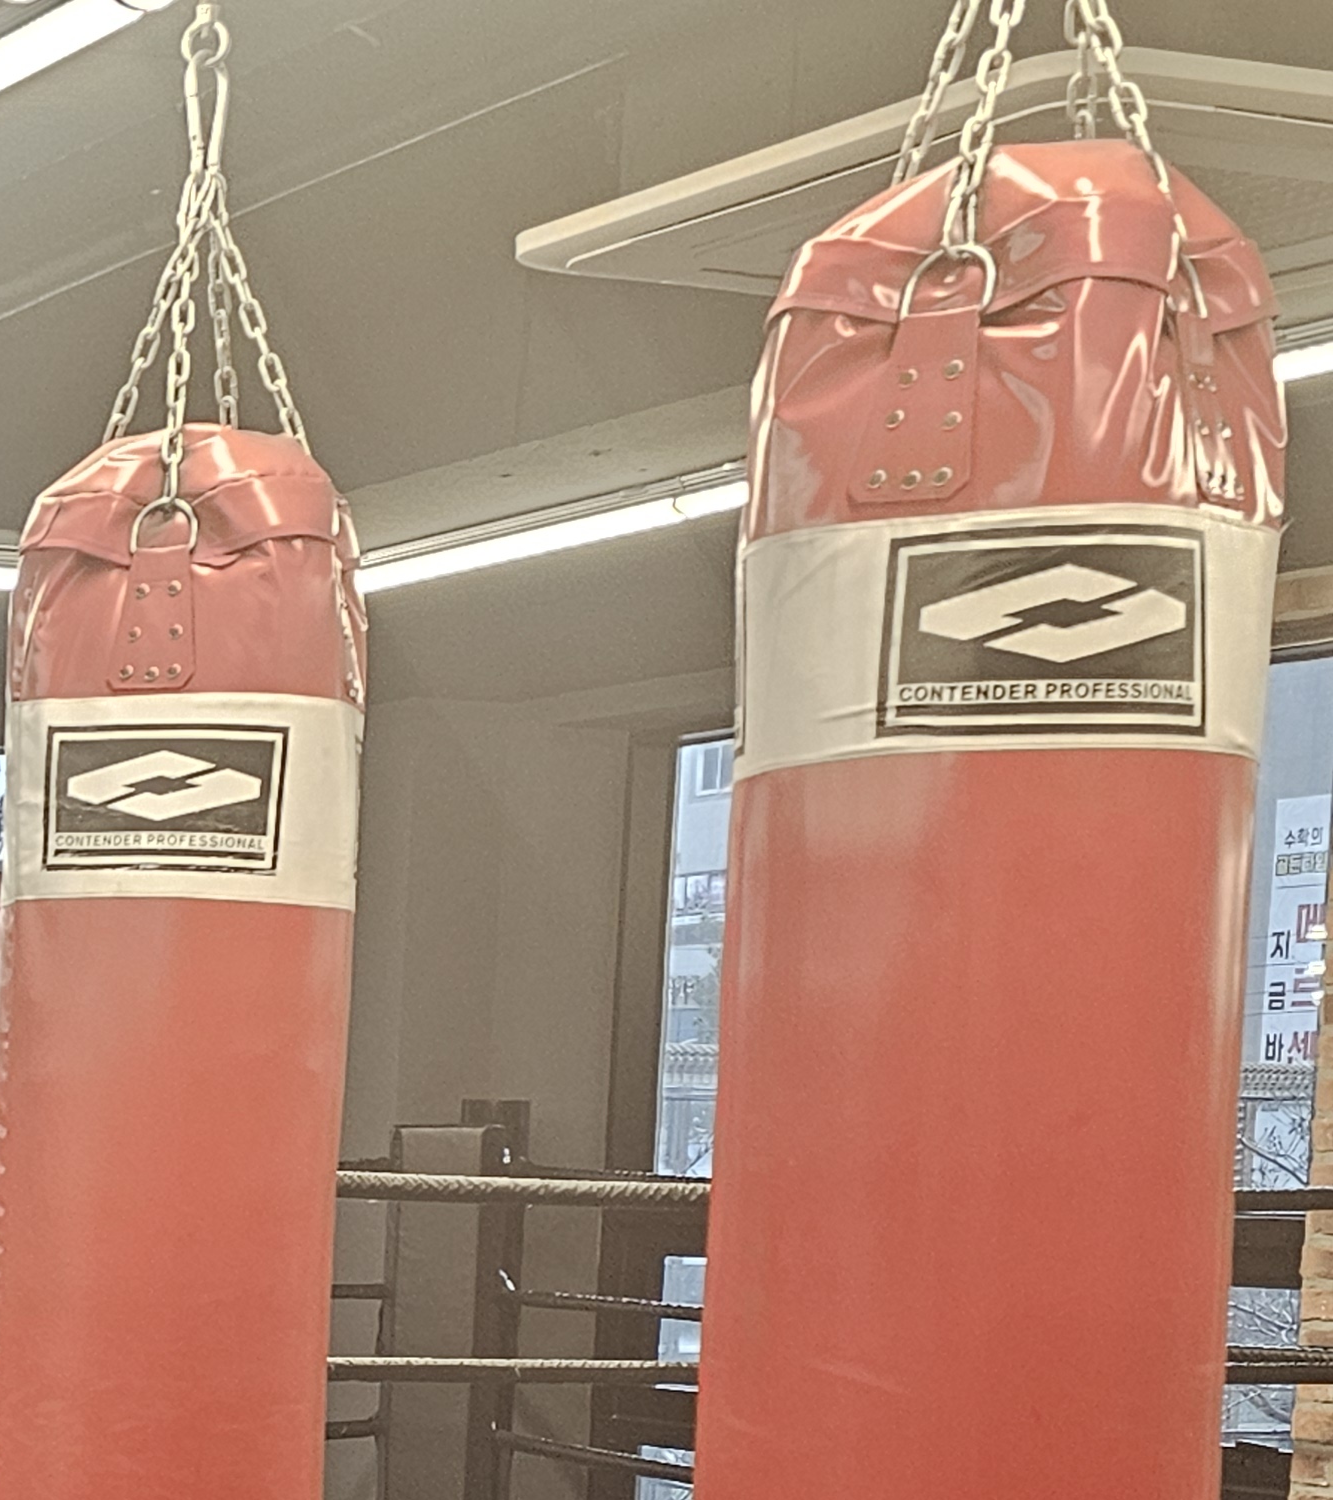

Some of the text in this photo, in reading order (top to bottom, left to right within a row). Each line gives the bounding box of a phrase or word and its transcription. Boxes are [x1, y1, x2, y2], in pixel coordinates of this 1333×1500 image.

[898, 681, 1193, 703] CONTENDER PROFESSIONAL
[54, 833, 265, 851] CONTENDER PROFESSIONAL
